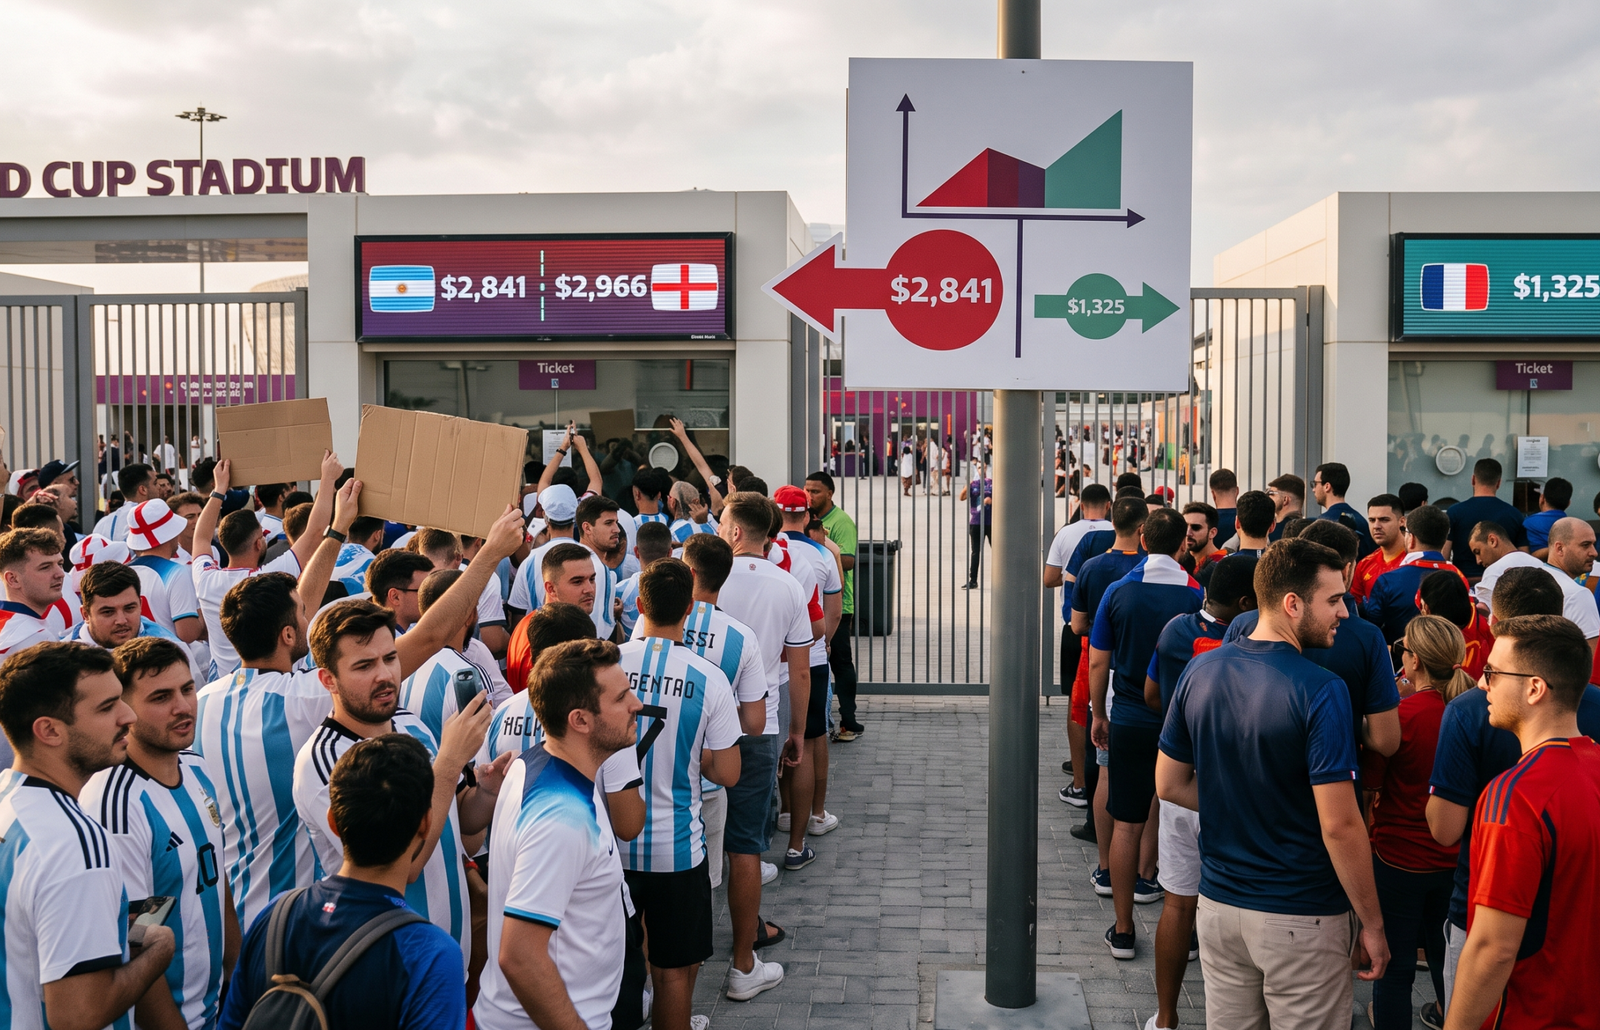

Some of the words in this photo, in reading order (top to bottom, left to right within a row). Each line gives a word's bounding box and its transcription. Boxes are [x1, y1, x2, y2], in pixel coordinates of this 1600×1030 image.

[42, 161, 136, 198] CUP
[146, 156, 366, 196] STADIUM
[440, 274, 526, 303] $2,841
[554, 273, 647, 302] $2,966
[890, 274, 993, 308] $2,841
[1513, 272, 1600, 302] $1,325
[1067, 298, 1125, 317] $1,325
[537, 362, 575, 373] Ticket
[1515, 363, 1553, 374] Ticket
[683, 628, 715, 648] SSI
[625, 671, 695, 699] GENTAO
[196, 842, 220, 895] 10
